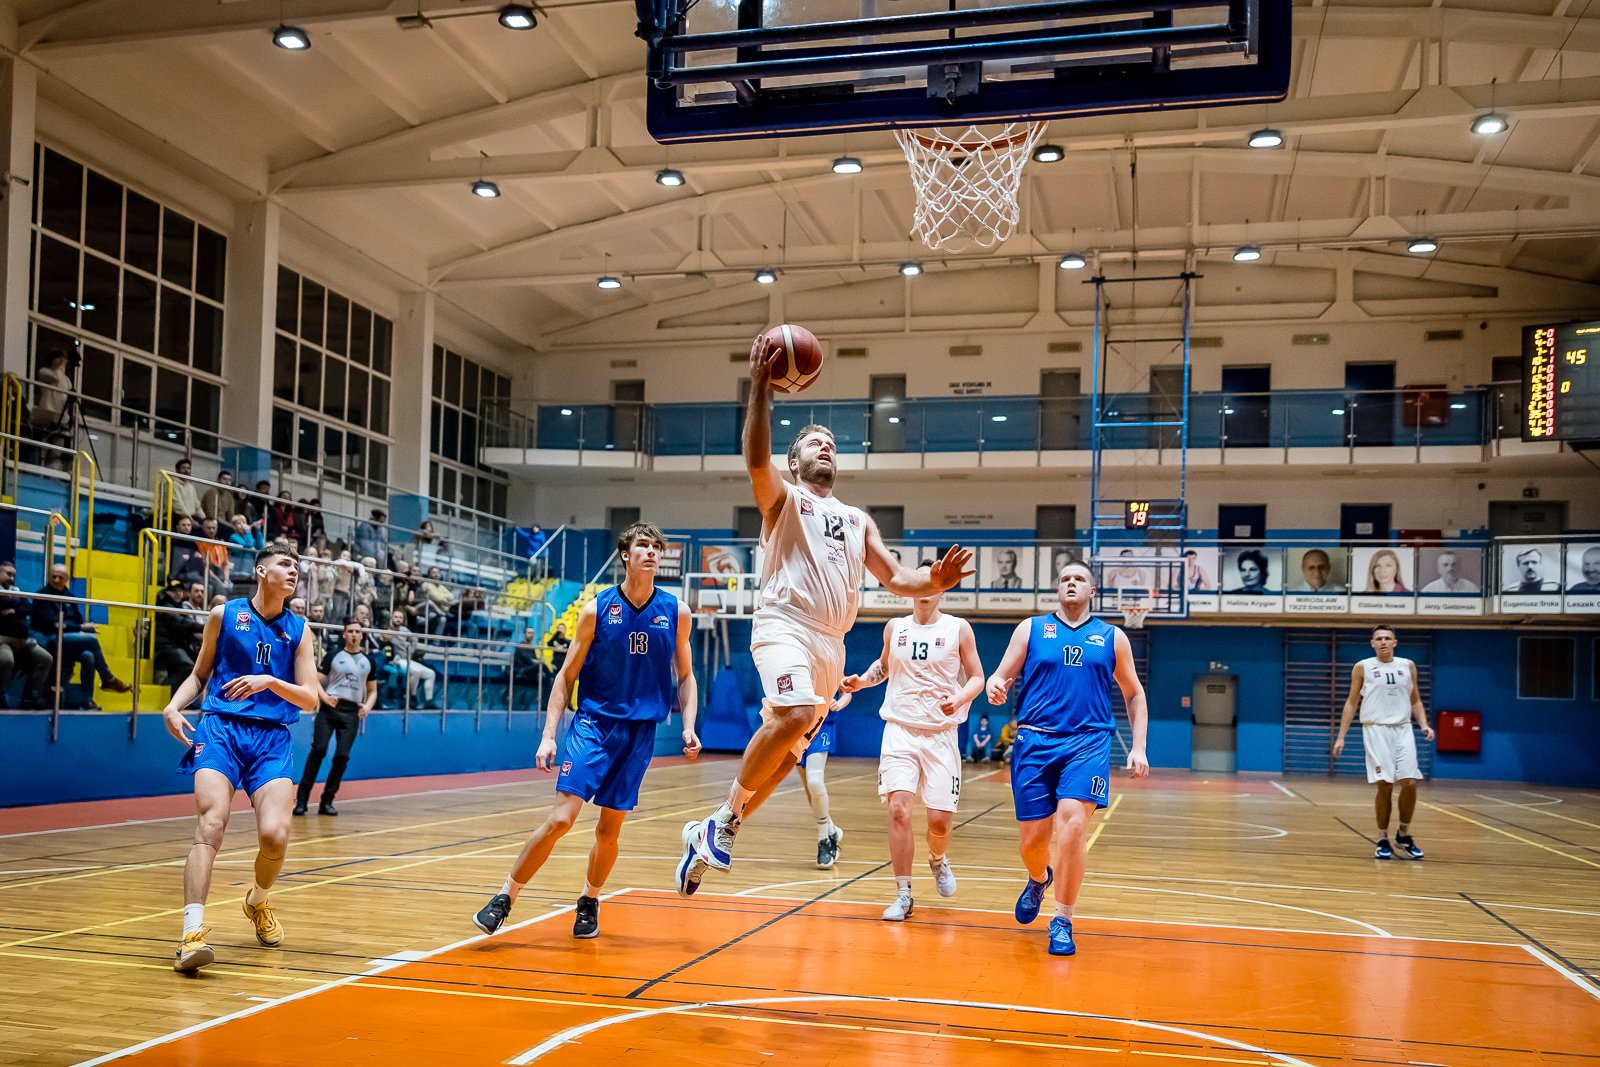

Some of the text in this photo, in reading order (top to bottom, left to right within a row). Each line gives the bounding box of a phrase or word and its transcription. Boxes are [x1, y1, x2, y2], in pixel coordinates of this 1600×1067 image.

[1566, 349, 1587, 365] 45
[1561, 381, 1571, 393] 0
[822, 514, 845, 541] 12
[1132, 511, 1147, 526] 19
[255, 640, 272, 665] 11
[628, 631, 649, 655] 13
[911, 641, 929, 661] 13
[1062, 644, 1083, 667] 12
[1385, 672, 1397, 685] 11
[1090, 775, 1107, 798] 12
